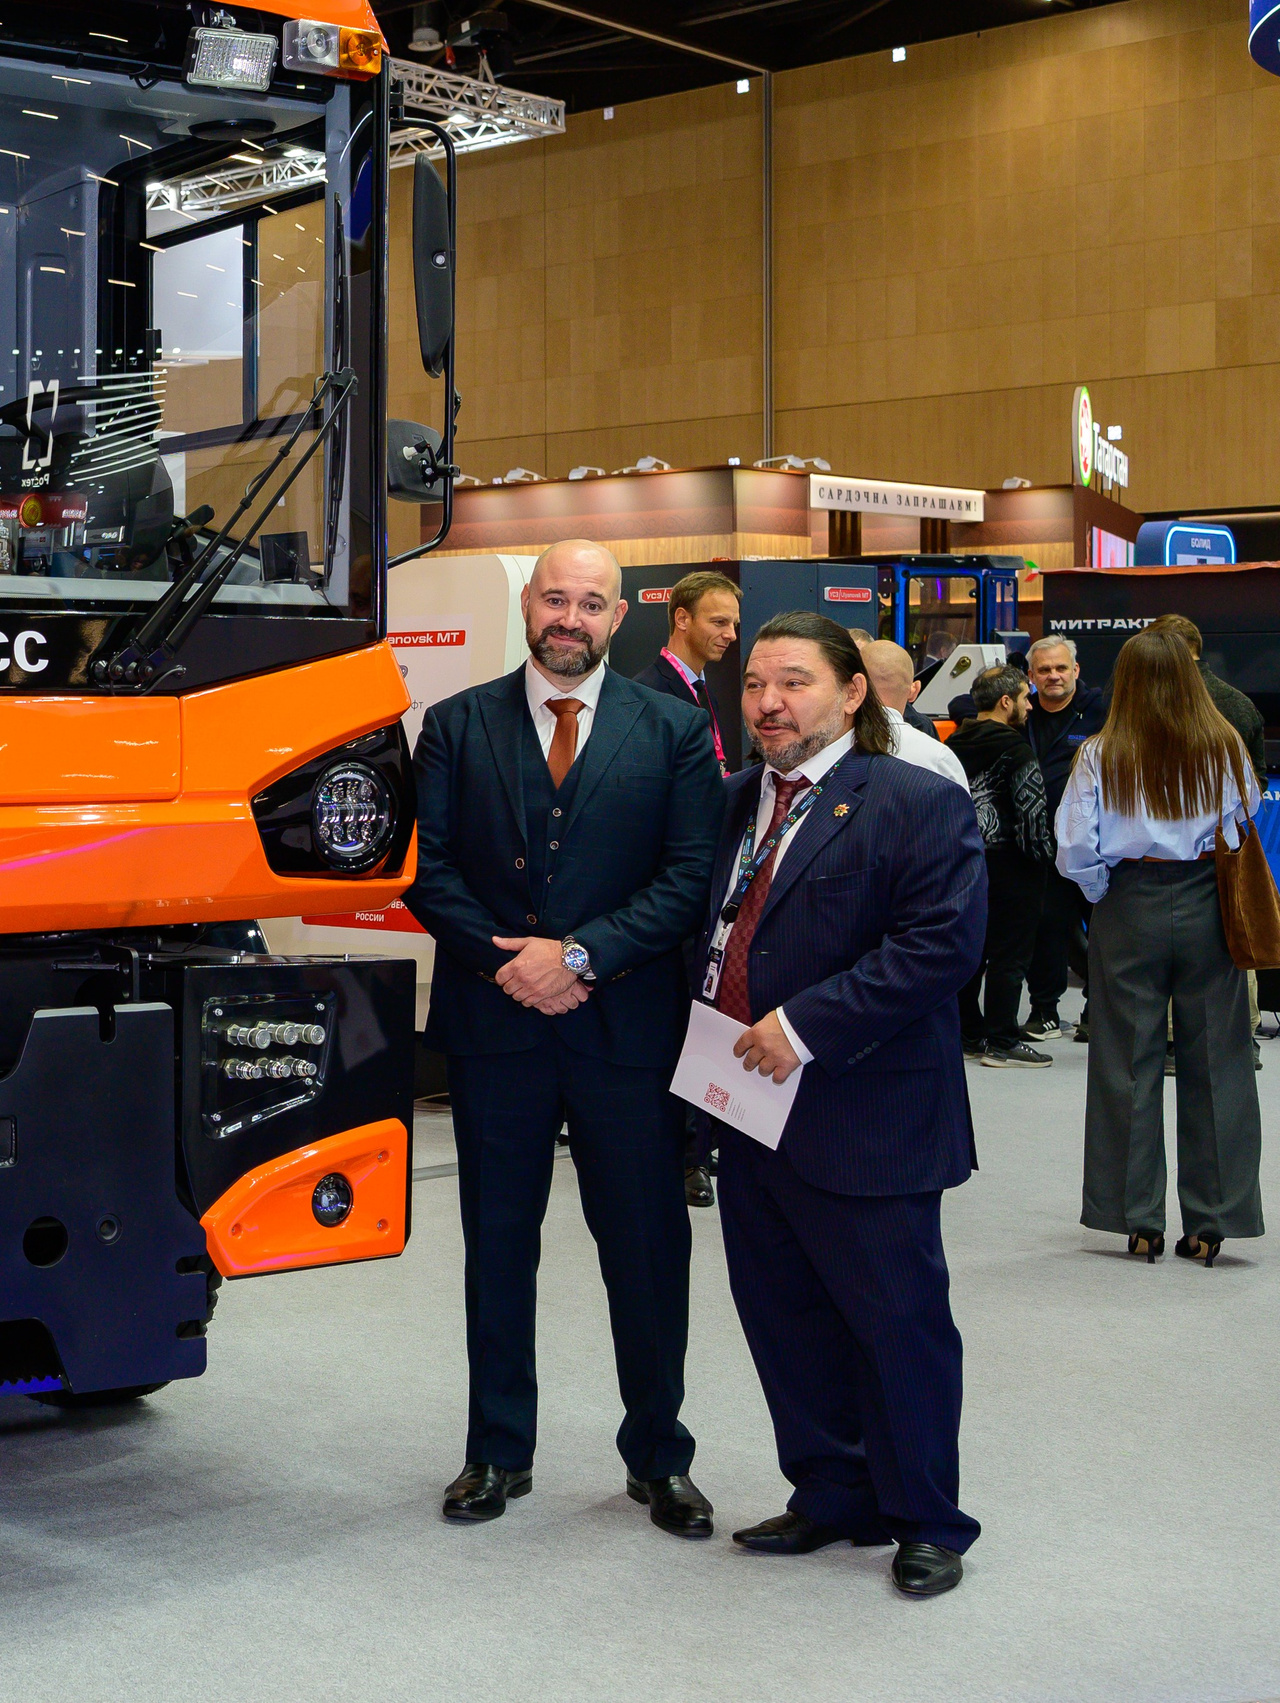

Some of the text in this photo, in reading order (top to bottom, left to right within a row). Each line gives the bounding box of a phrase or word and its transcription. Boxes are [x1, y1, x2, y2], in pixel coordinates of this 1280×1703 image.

[1093, 421, 1128, 490] Татарстан
[818, 487, 977, 512] САРДЭЧНА ЗАПРАШАЕМ!
[1190, 537, 1211, 550] БОЛИД
[385, 631, 460, 645] anovsk MT
[355, 912, 385, 922] РОССИИ
